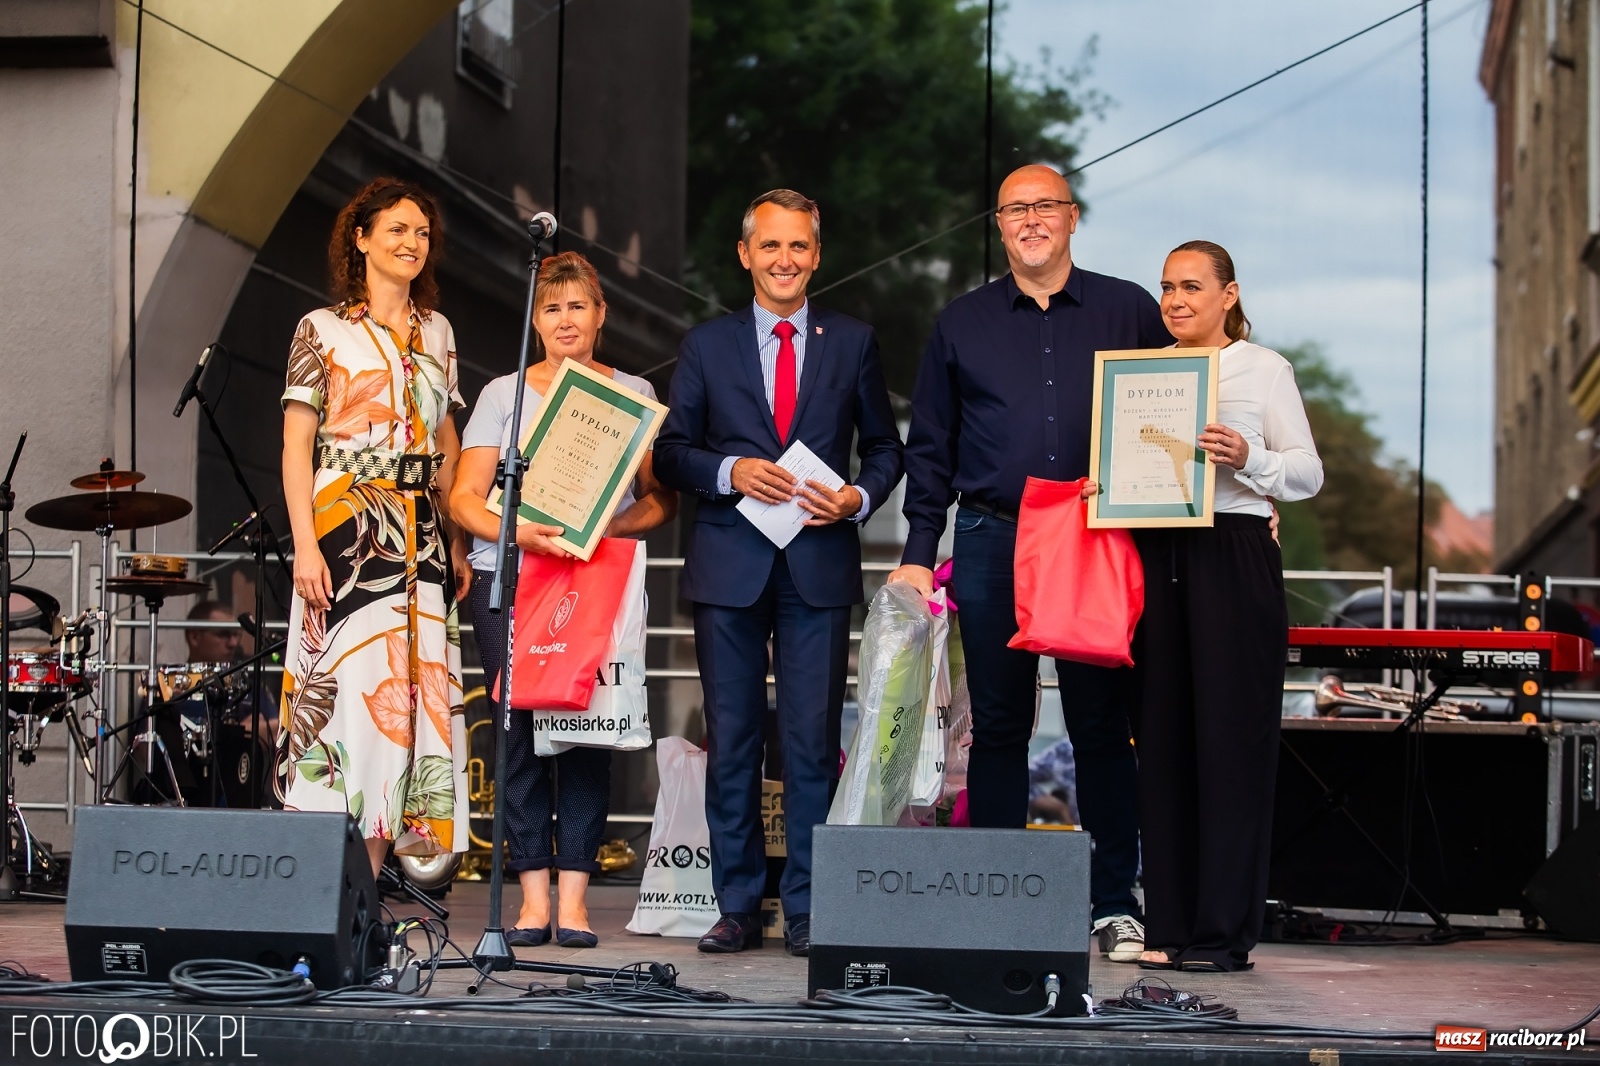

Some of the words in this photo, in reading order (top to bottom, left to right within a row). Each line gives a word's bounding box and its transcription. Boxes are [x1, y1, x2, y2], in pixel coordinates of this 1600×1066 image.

[1127, 388, 1185, 399] DYPLOM
[570, 409, 621, 439] DYPLOM
[568, 452, 599, 470] MIEJSCA
[112, 850, 298, 879] POL-AUDIO
[856, 870, 1046, 898] POL-AUDIO
